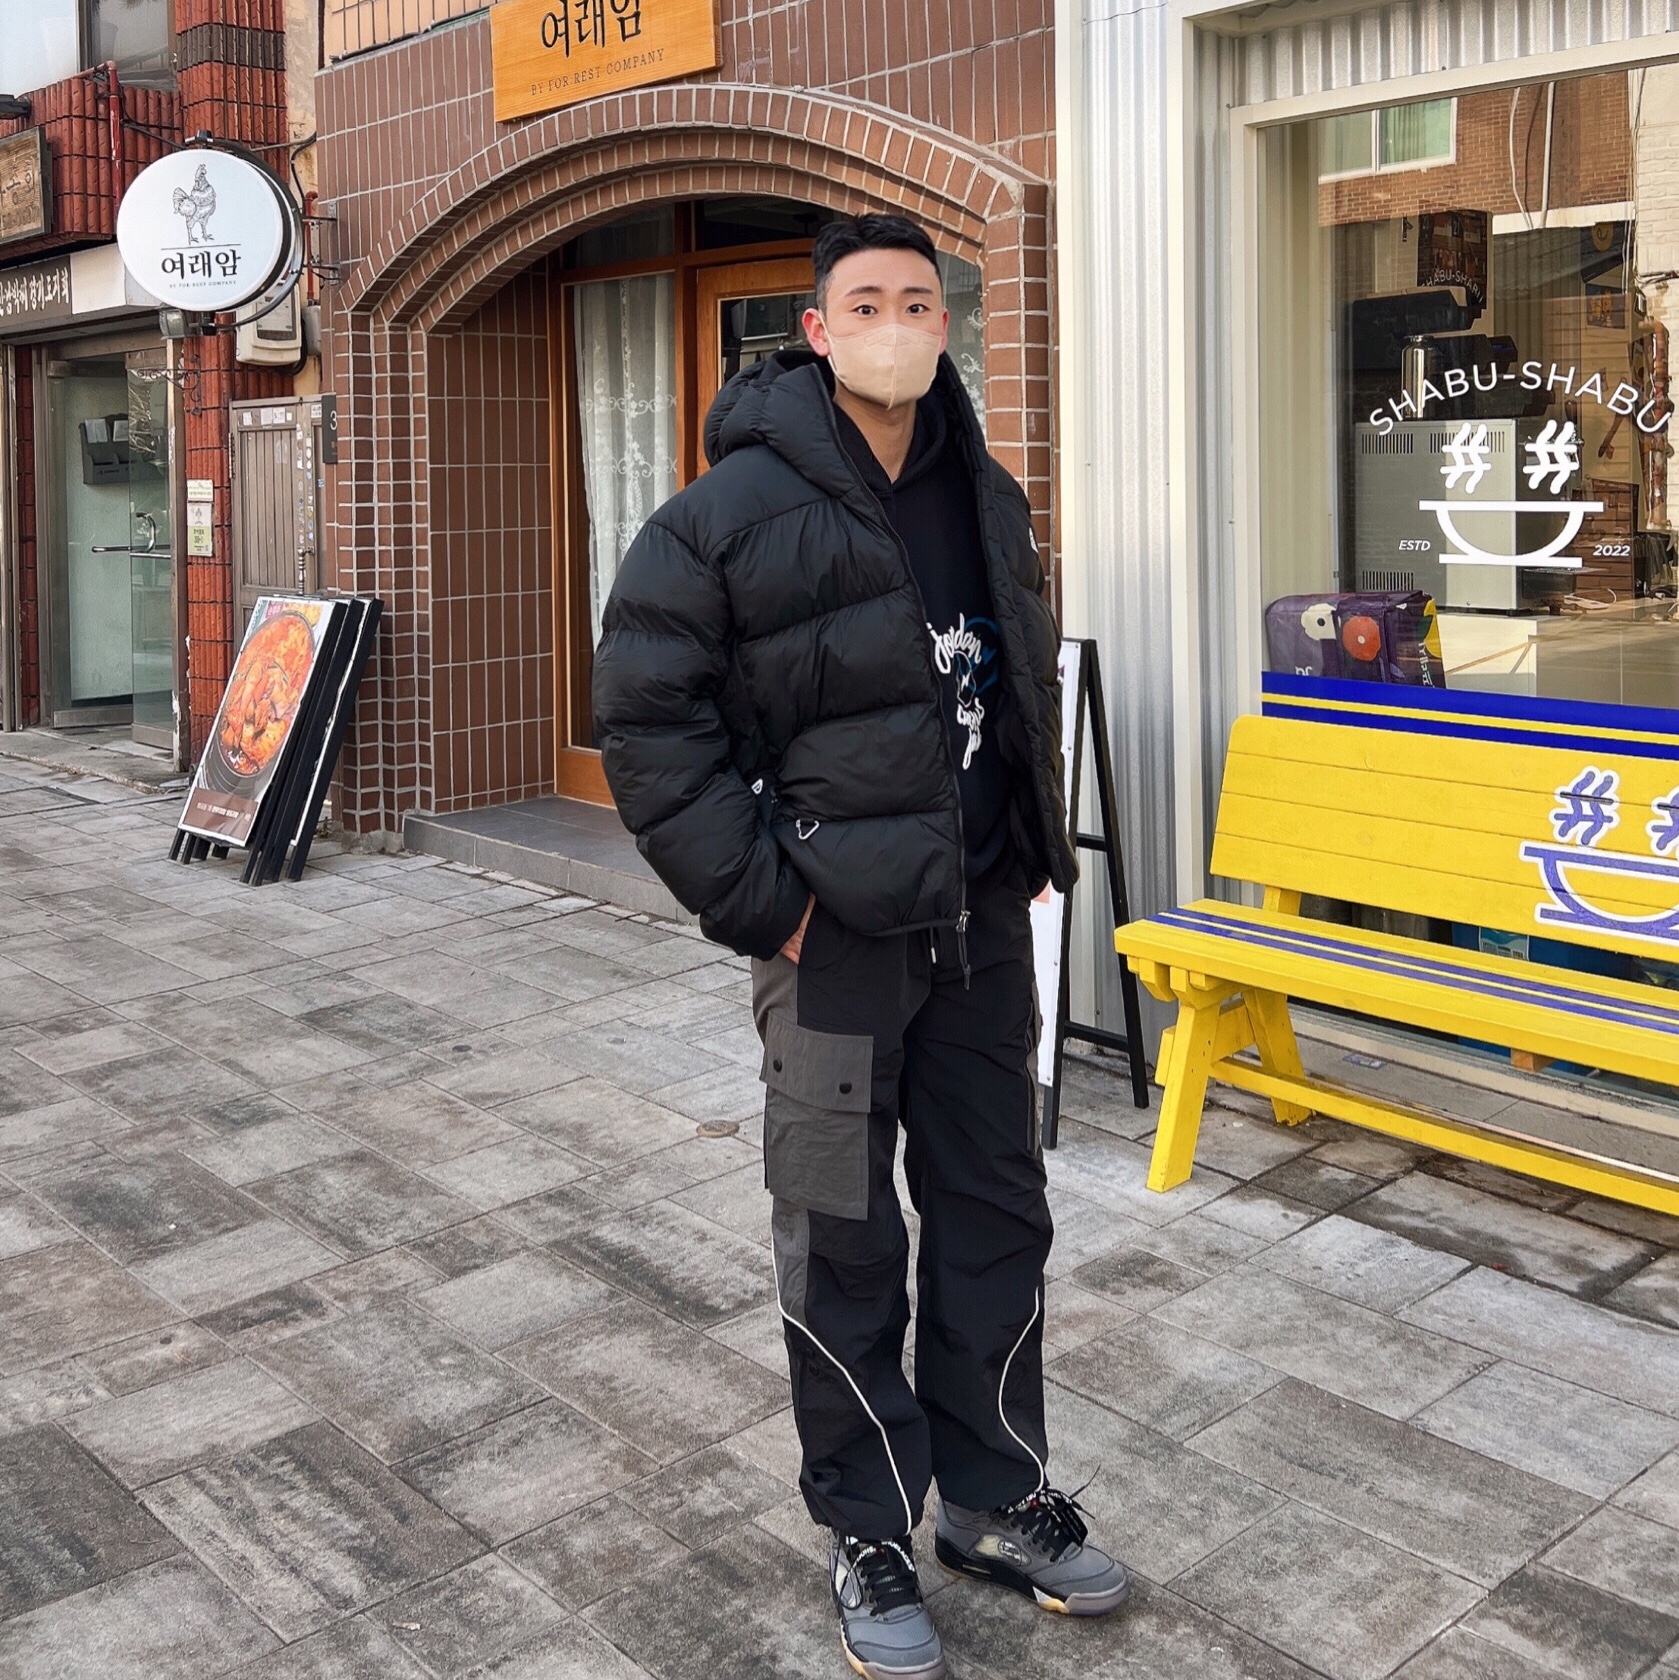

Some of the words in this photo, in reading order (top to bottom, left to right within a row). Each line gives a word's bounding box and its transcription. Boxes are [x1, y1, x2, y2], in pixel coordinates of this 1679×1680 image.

[531, 81, 545, 96] BY
[548, 76, 569, 92] FOR
[573, 68, 601, 85] REST
[606, 48, 665, 75] COMPANY
[161, 249, 242, 280] 여래암
[1369, 361, 1672, 436] SHABU-SHABU
[1398, 539, 1431, 551] ESTD
[1592, 544, 1631, 557] 2022
